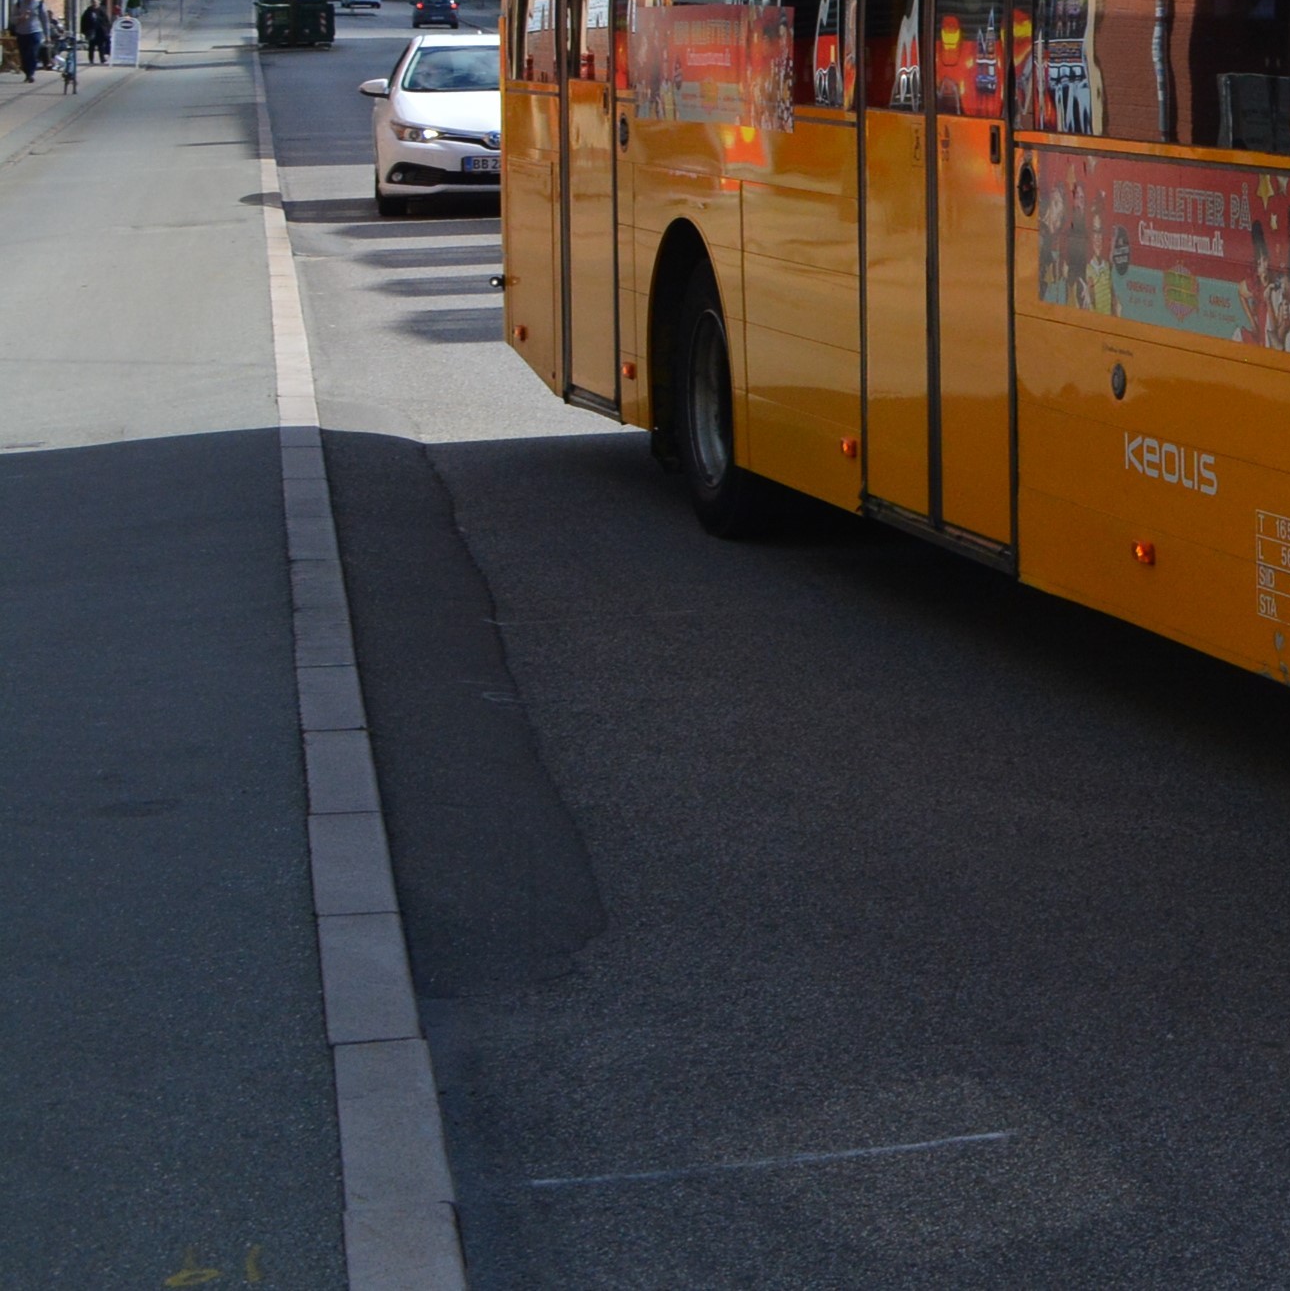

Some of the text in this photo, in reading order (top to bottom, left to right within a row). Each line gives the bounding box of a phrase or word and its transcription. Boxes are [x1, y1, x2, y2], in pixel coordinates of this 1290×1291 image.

[473, 159, 489, 169] BB
[1112, 180, 1252, 231] KØB BILLETTER PÅ
[1258, 513, 1265, 533] T
[1258, 540, 1264, 560] L
